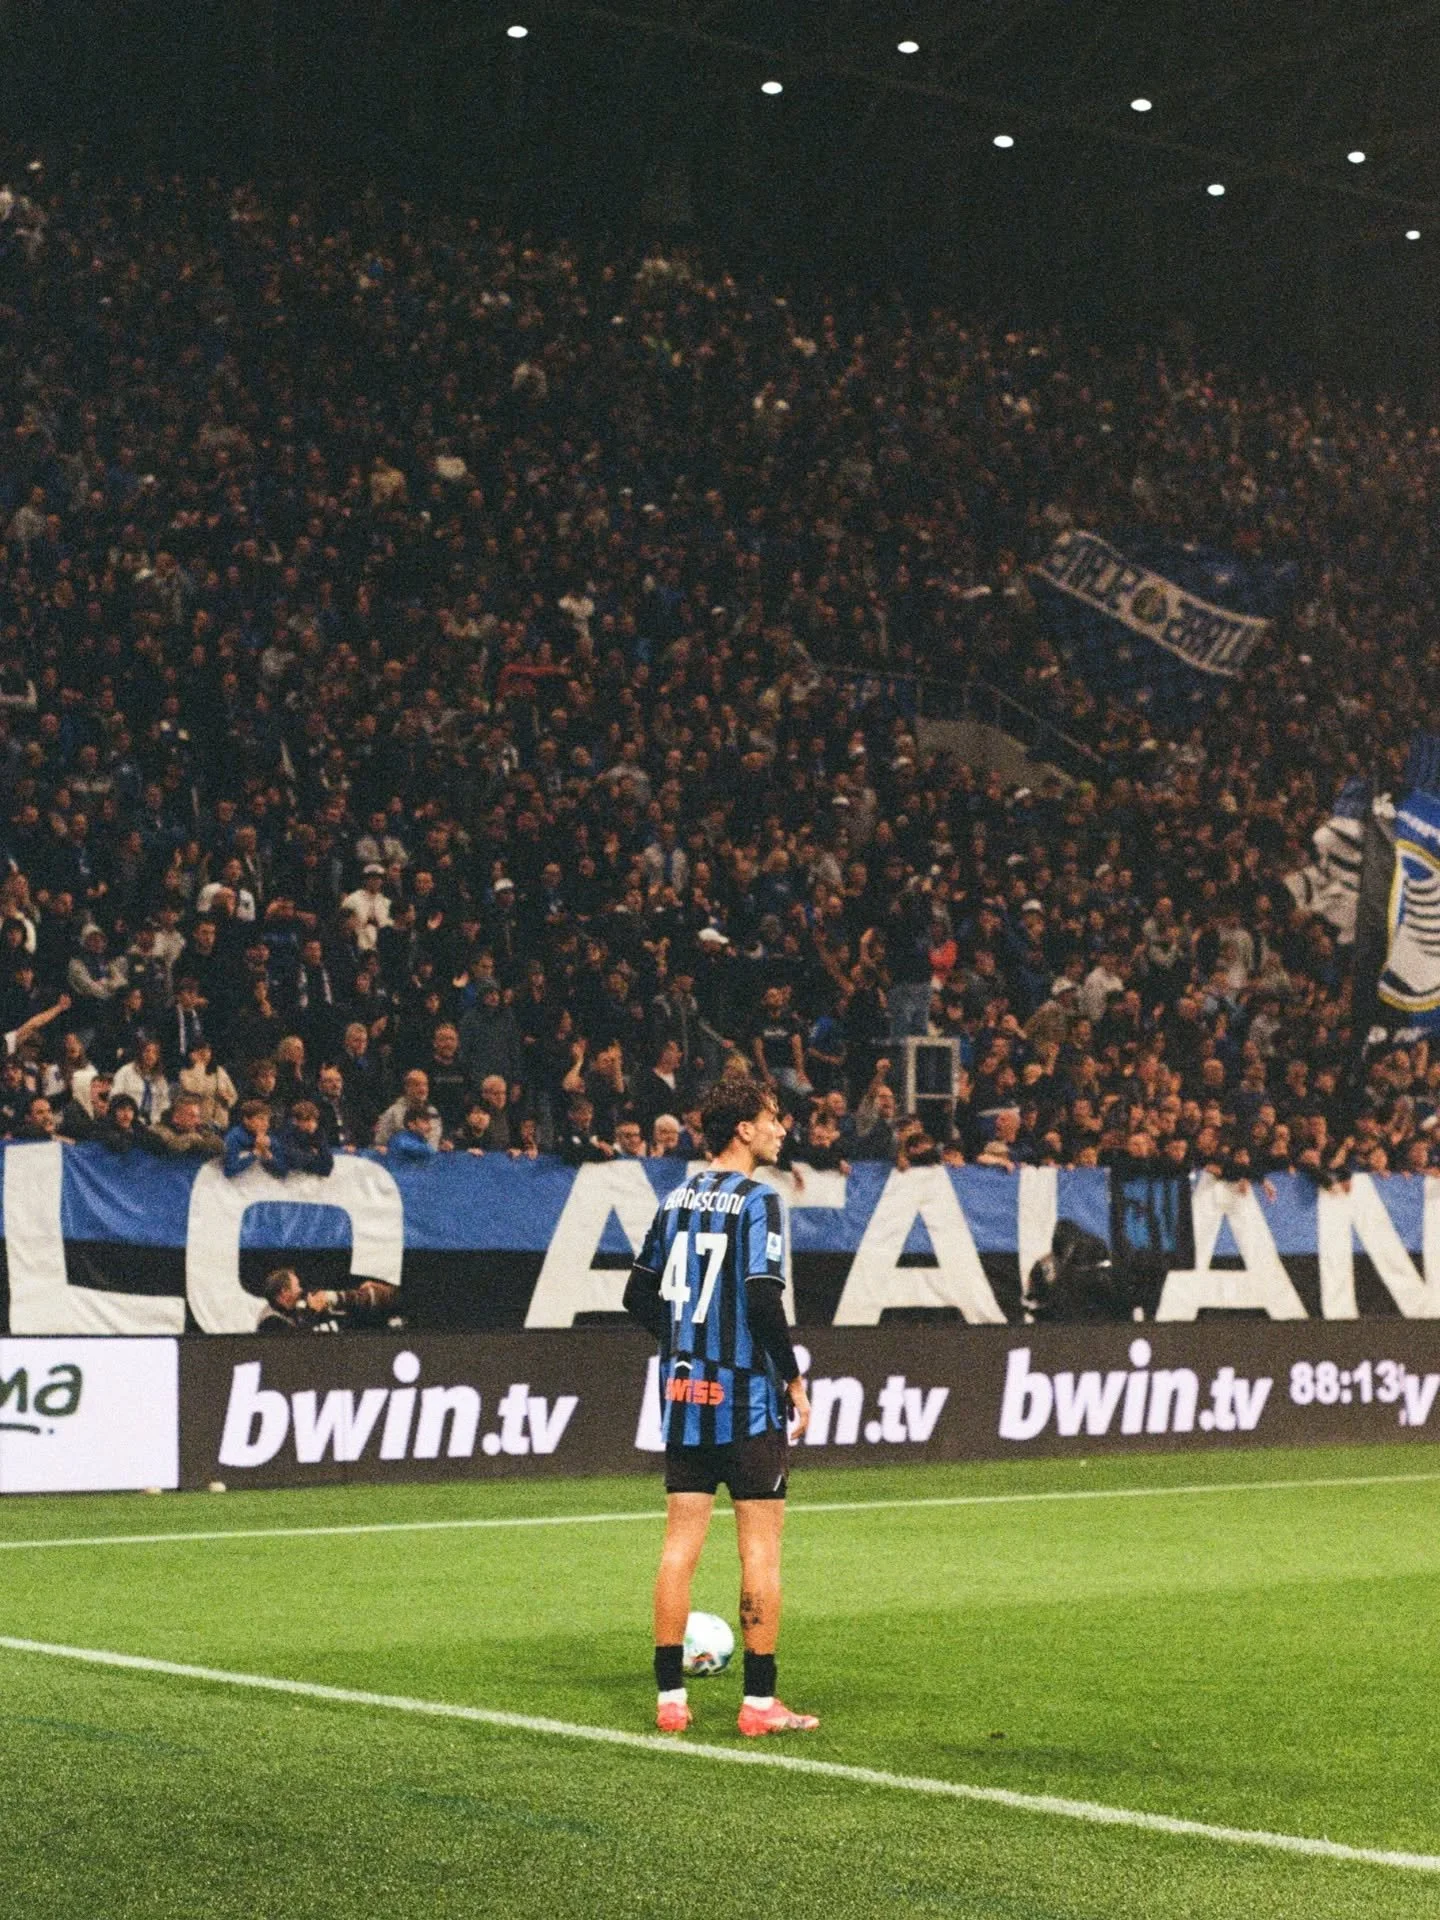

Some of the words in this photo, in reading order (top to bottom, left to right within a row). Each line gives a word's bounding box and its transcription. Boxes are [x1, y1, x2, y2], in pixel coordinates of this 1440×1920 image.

[660, 1231, 728, 1323] 47
[218, 1350, 578, 1467] bwin.tv
[998, 1337, 1274, 1440] bwin.tv
[1289, 1359, 1401, 1405] 88:13
